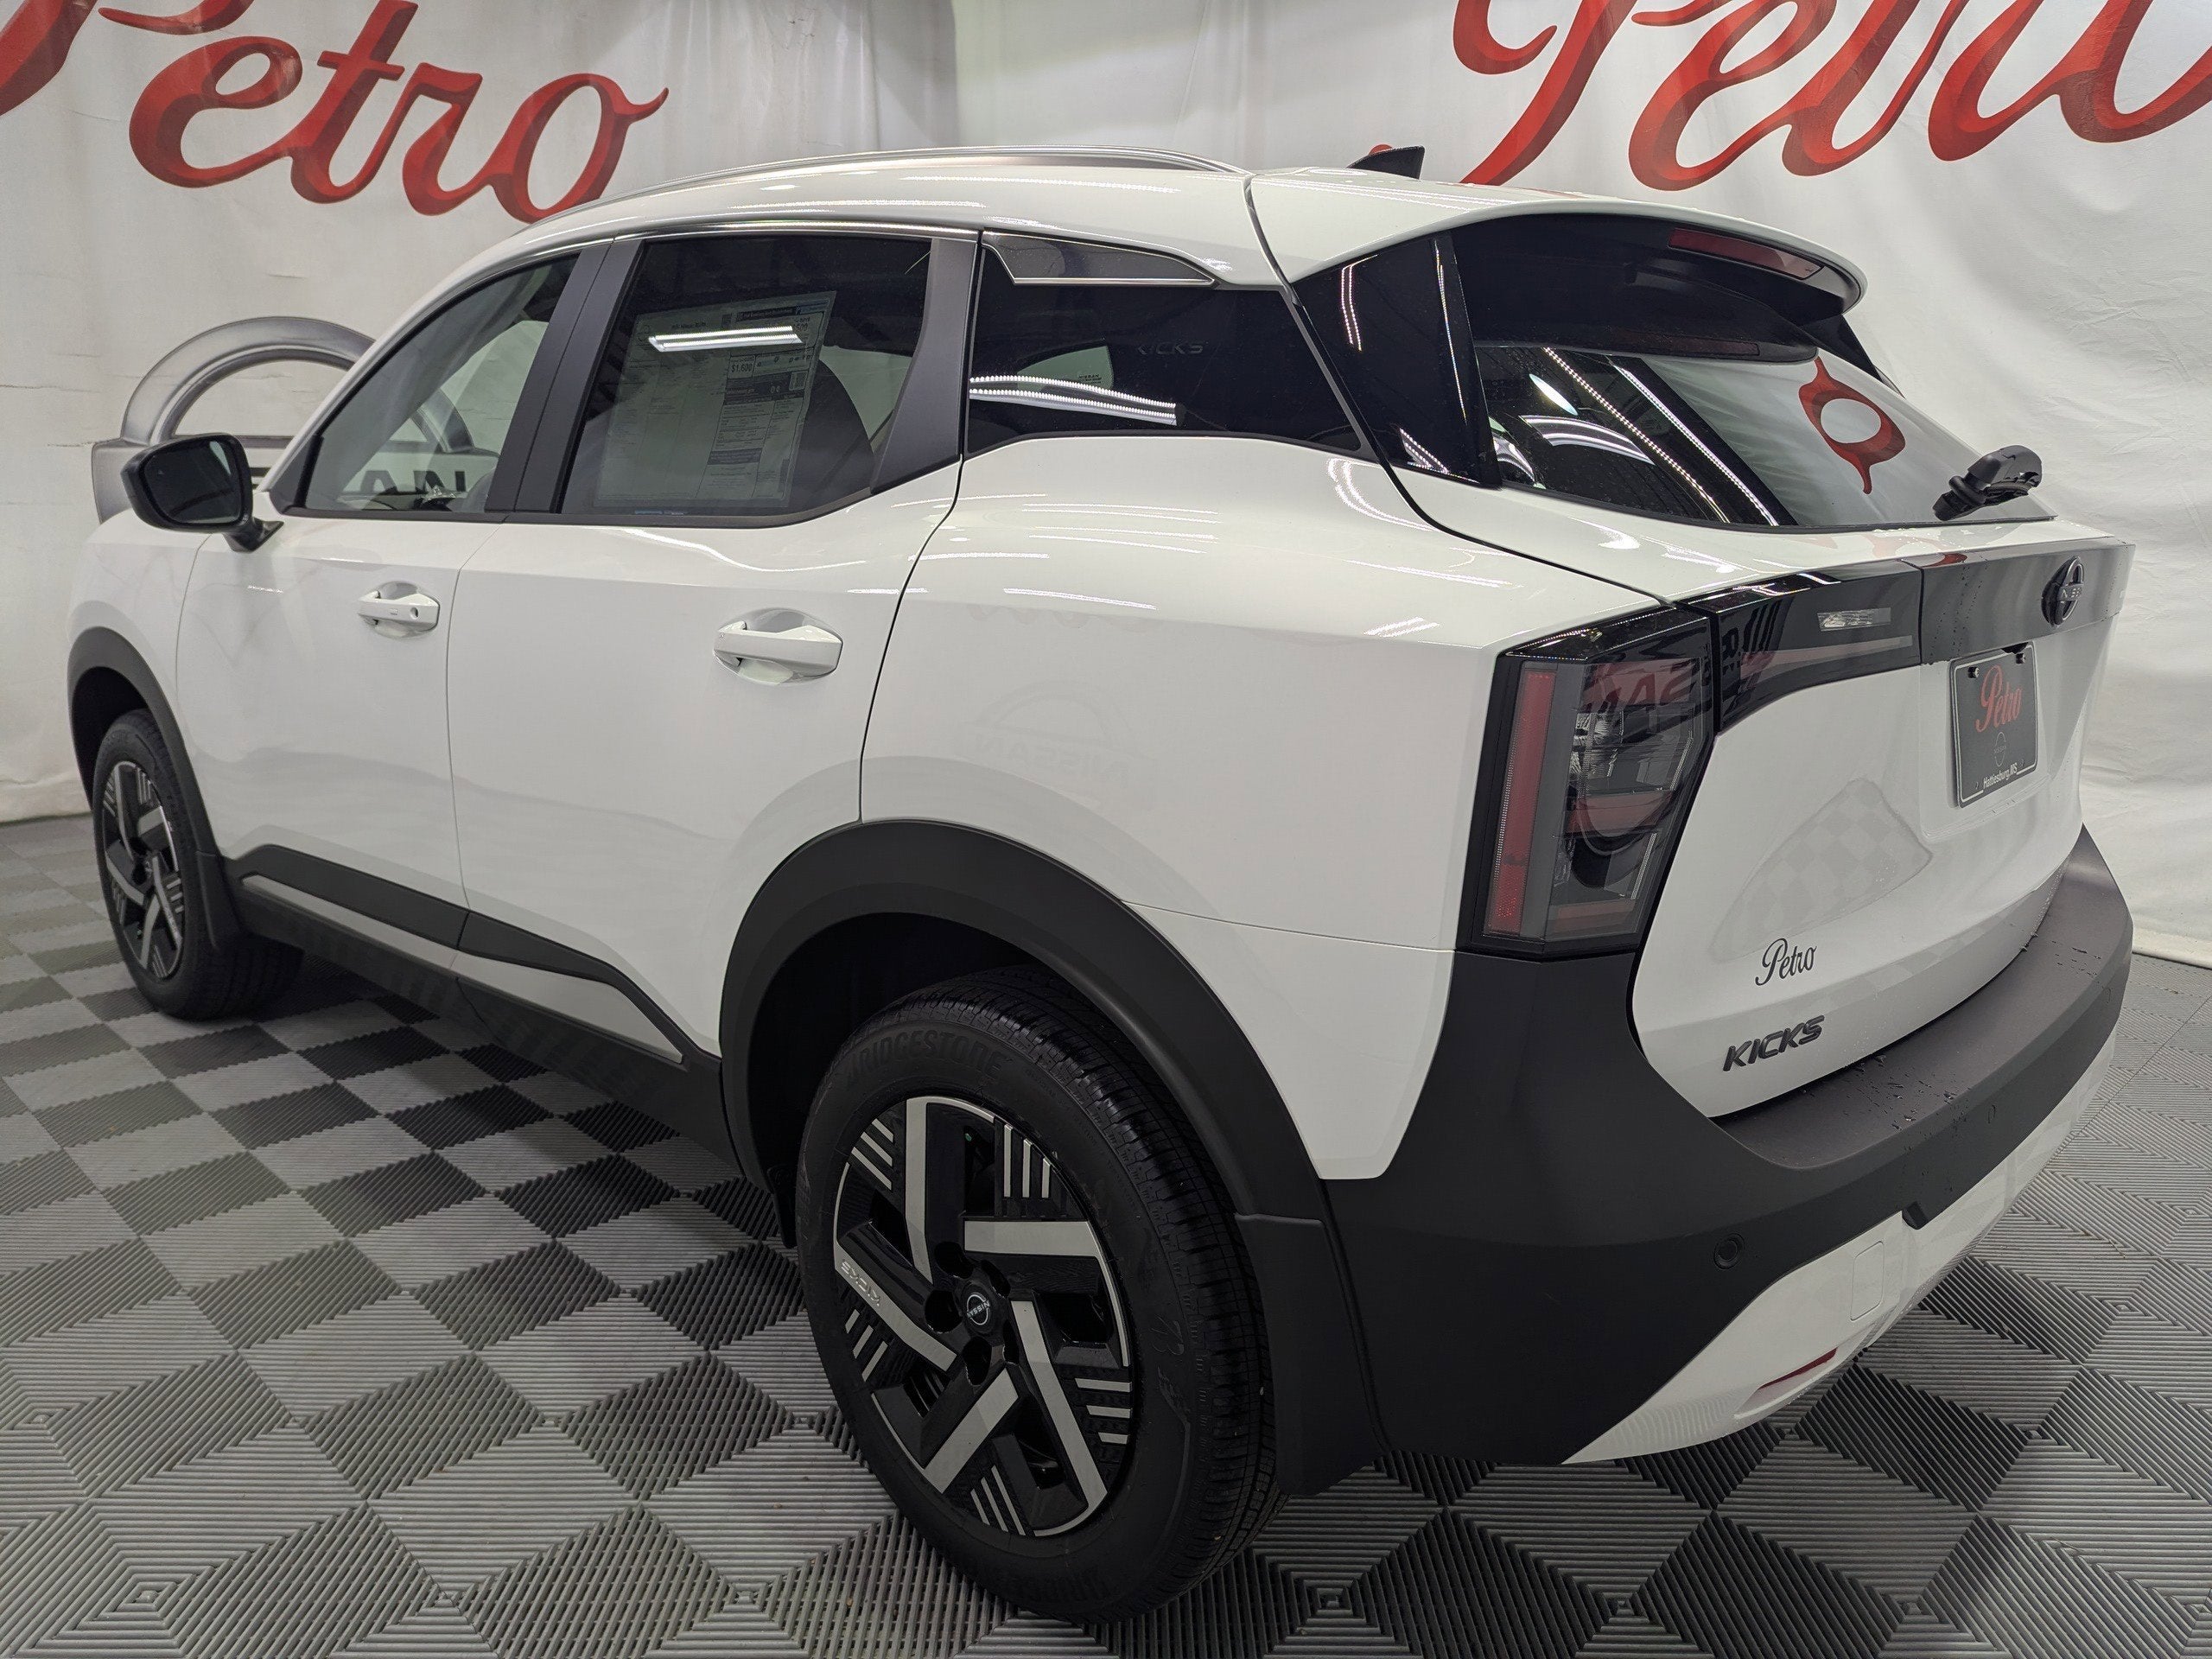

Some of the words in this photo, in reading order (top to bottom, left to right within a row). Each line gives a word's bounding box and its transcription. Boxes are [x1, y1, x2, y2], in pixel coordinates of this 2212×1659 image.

[0, 0, 670, 224] etro
[1975, 665, 2023, 733] Petro
[1755, 938, 1817, 986] Petro
[1722, 1014, 1825, 1072] KICKS
